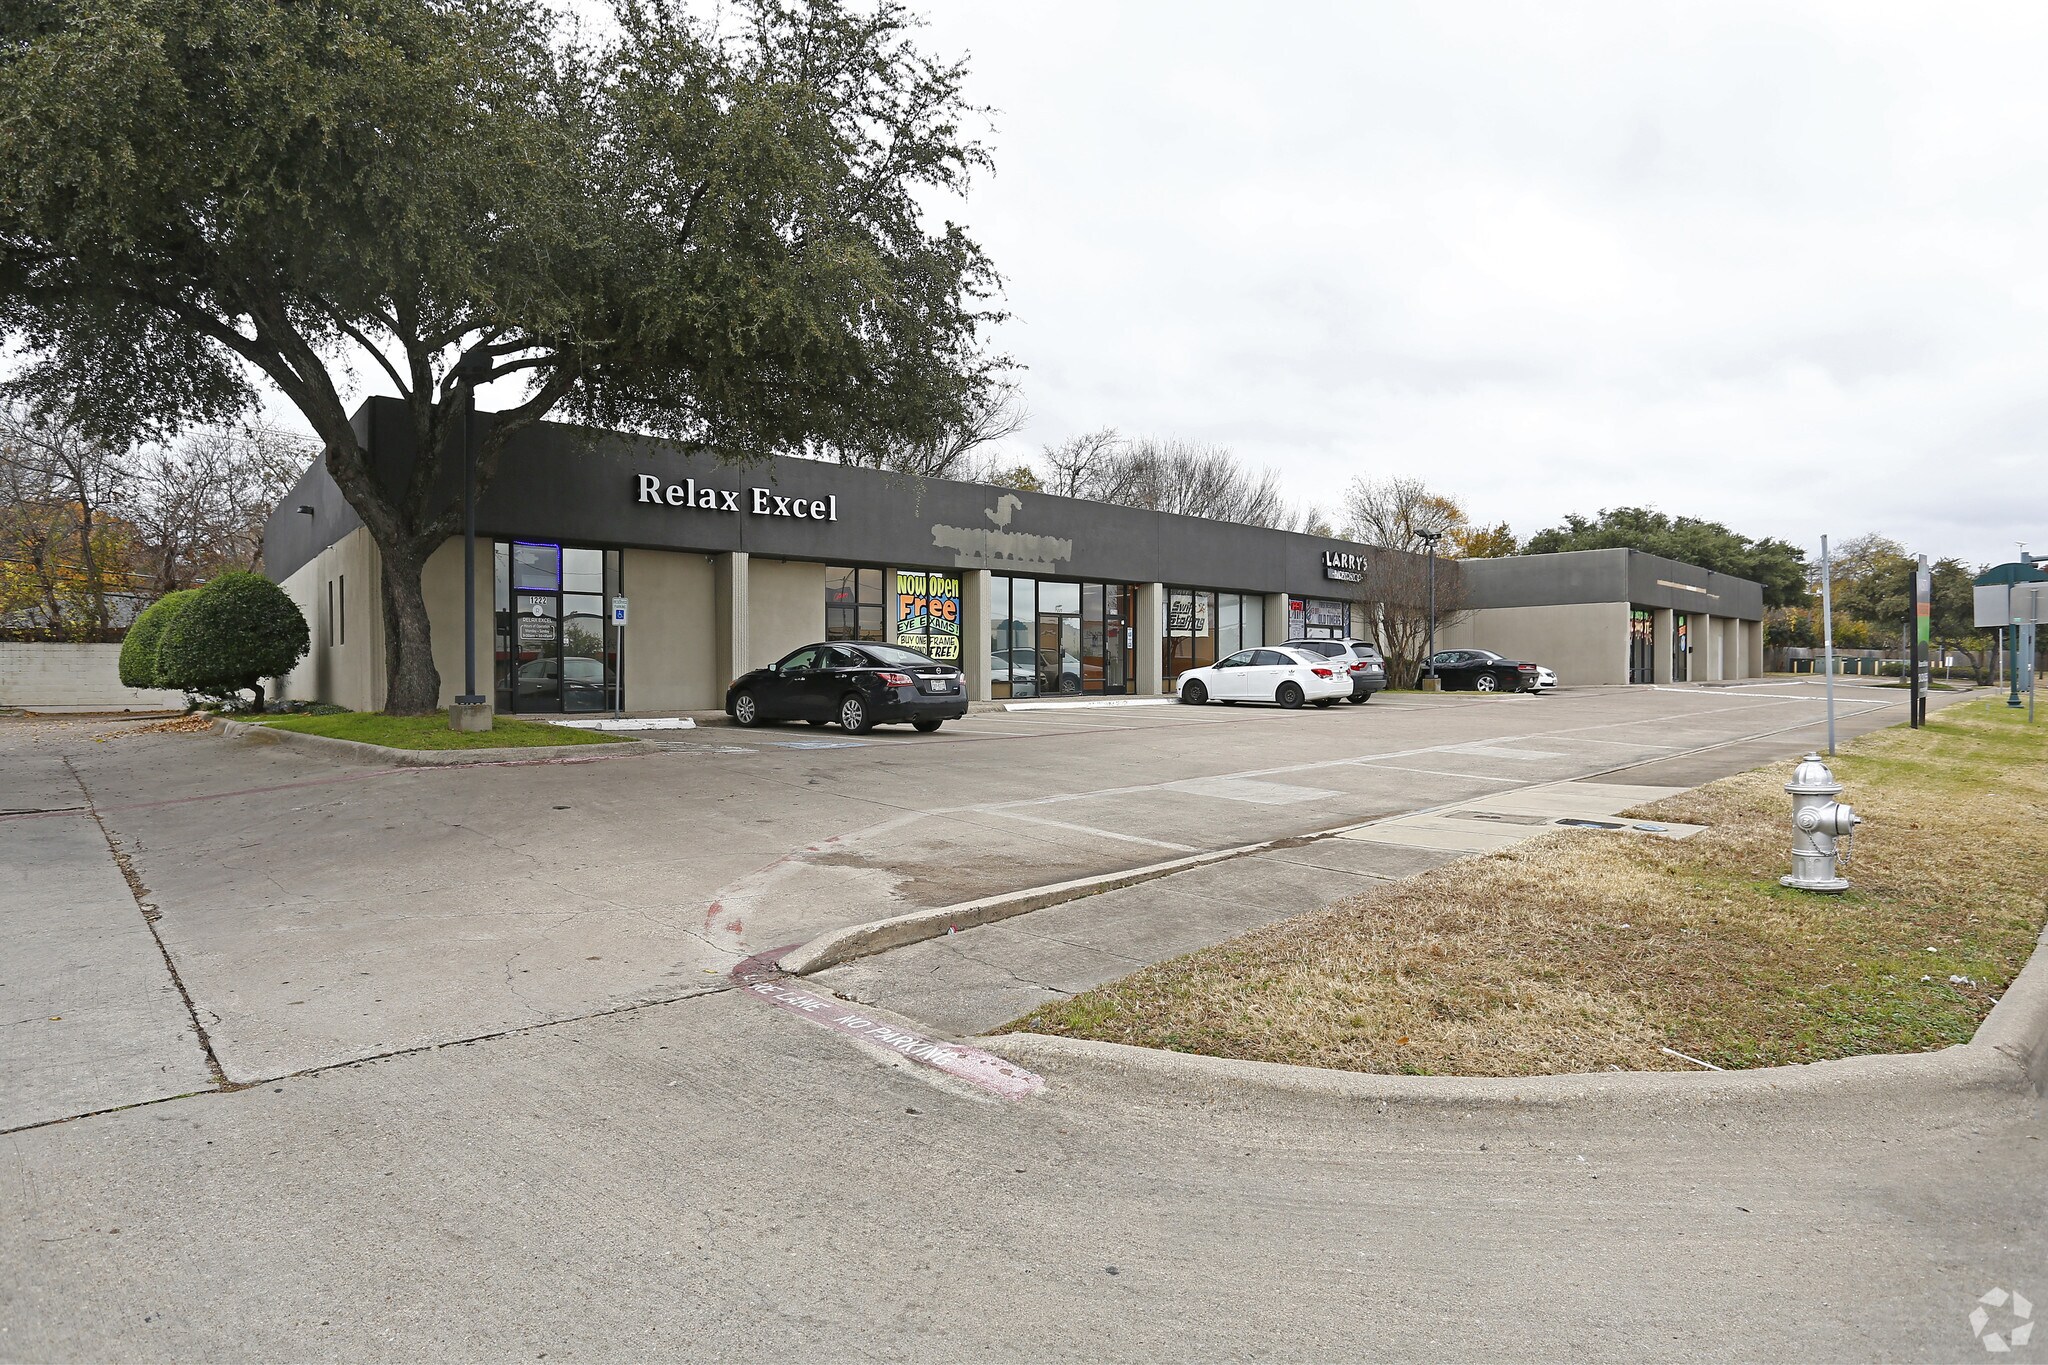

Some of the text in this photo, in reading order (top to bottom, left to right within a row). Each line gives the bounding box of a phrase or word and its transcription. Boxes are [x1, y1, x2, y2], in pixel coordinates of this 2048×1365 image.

[637, 473, 838, 521] Relax Excel
[1325, 550, 1368, 571] LARRY'S
[897, 575, 959, 598] NOW Open
[530, 596, 547, 605] 1222
[900, 595, 958, 621] Free
[898, 616, 960, 634] EYE EXAMS!
[901, 635, 955, 646] BUY ONE FRAME
[930, 645, 957, 657] FREE!
[773, 991, 831, 1012] LANE
[833, 1015, 872, 1029] NO
